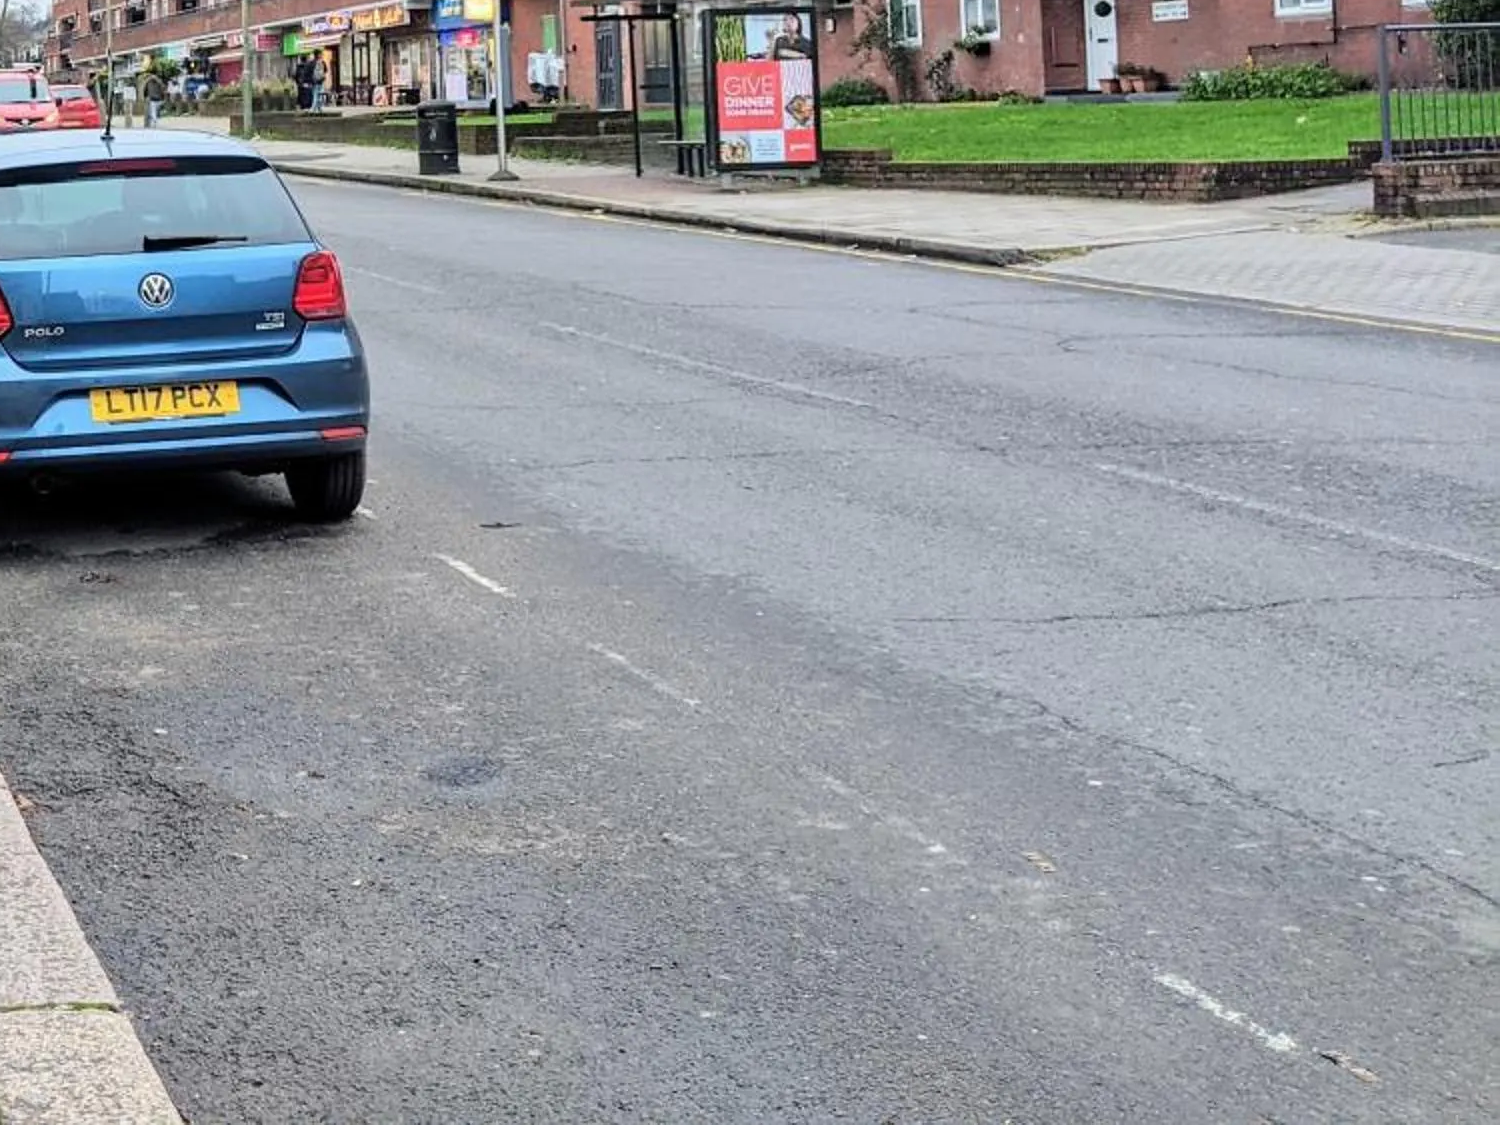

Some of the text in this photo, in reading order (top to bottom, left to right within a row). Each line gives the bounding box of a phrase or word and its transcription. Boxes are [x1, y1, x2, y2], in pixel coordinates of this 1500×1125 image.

[723, 75, 774, 96] GIVE
[724, 96, 776, 108] DINNER
[24, 326, 65, 338] POLO
[105, 384, 223, 414] LT17 PCX
